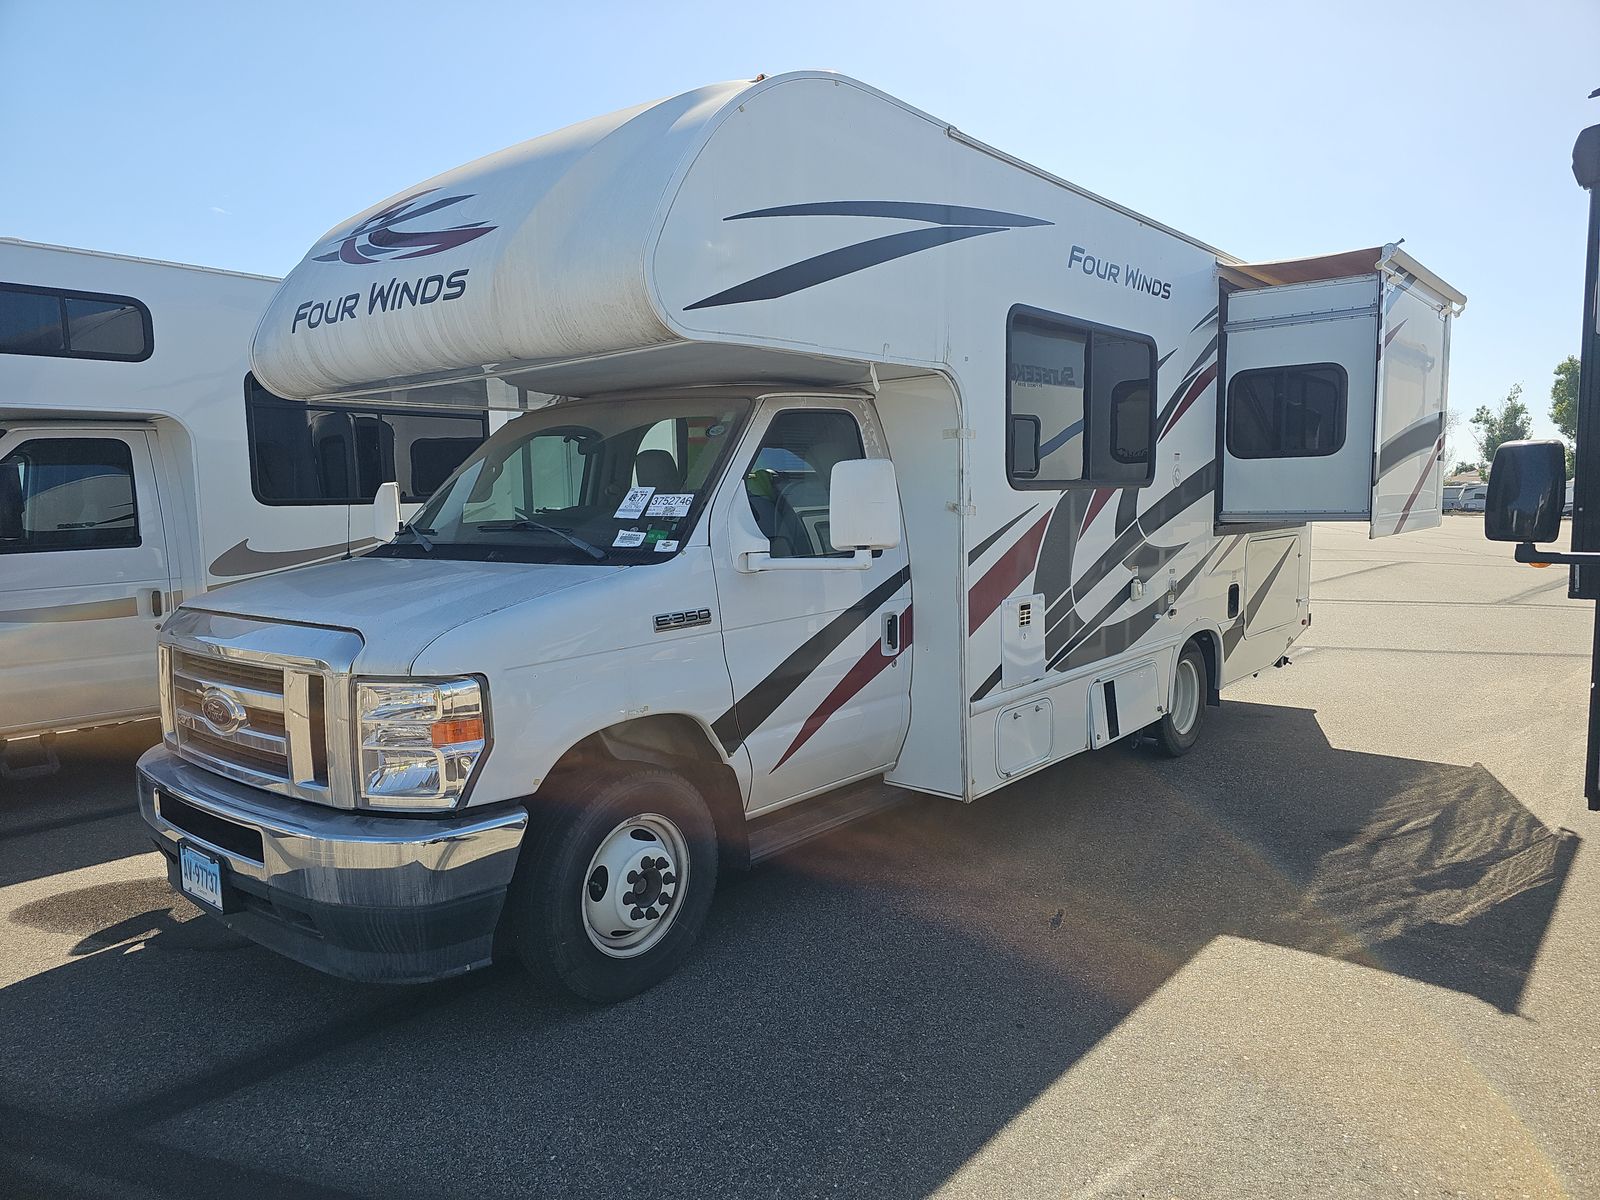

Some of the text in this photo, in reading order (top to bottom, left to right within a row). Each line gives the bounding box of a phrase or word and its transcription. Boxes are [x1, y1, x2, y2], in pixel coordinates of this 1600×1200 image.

[1068, 245, 1172, 300] FOUR WINDS
[291, 268, 470, 334] FOUR WINDS
[651, 496, 693, 506] 3752746
[655, 609, 712, 627] E-350
